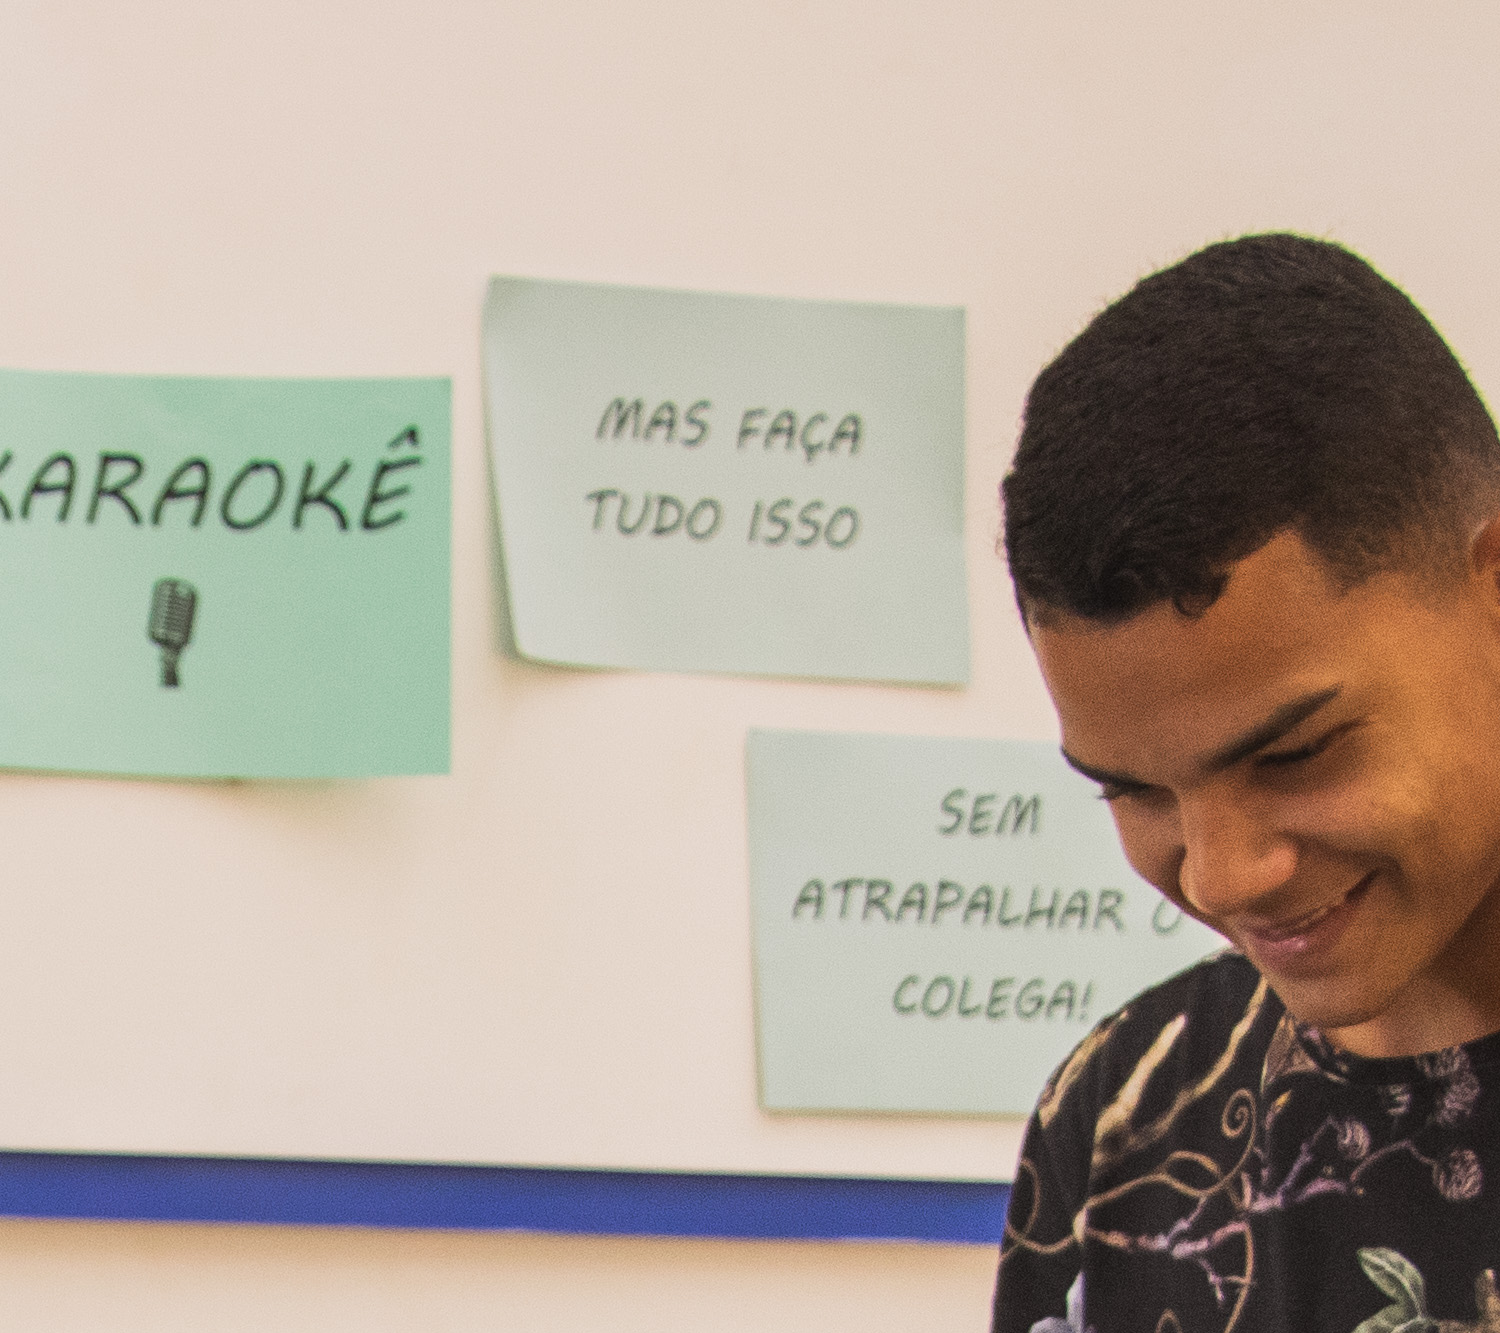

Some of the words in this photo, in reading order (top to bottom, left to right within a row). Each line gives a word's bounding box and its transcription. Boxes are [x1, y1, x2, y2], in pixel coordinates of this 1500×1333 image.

[594, 395, 714, 450] MAS
[735, 406, 866, 464] FAÇA
[584, 486, 725, 542] TUDO
[747, 497, 863, 550] ISSO
[936, 786, 1045, 838] SEM
[790, 876, 1127, 934] ATRAPALHAR
[891, 973, 1096, 1025] COLEGA!
